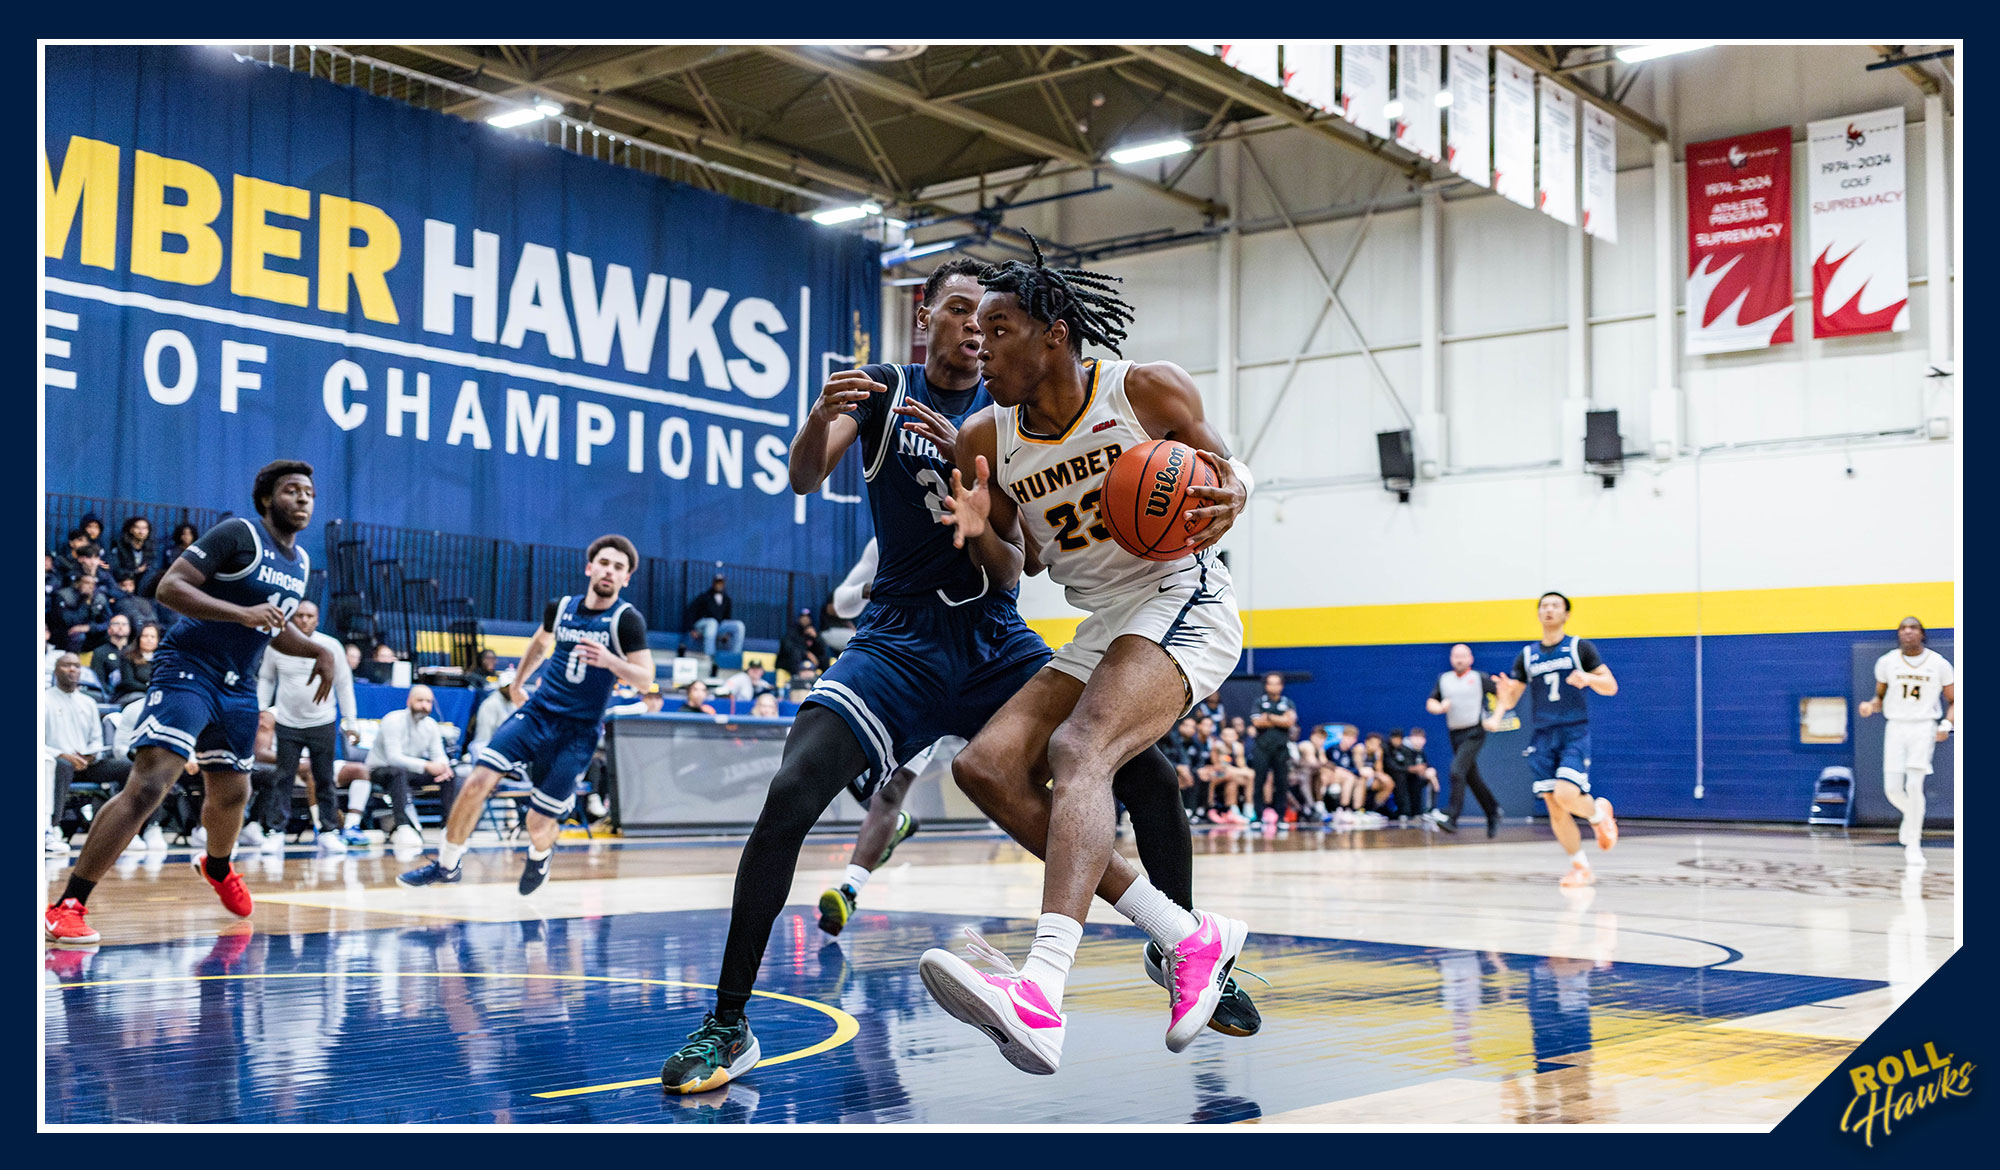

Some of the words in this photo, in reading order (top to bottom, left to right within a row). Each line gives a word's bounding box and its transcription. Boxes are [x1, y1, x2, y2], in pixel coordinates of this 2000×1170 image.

[1841, 175, 1873, 188] GOLF
[1708, 207, 1769, 226] PROGRAM
[1813, 189, 1905, 214] SUPREMACY
[1695, 223, 1783, 247] SUPREMACY
[422, 218, 791, 400] HAWKS
[143, 329, 268, 413] OF
[322, 358, 791, 495] CHAMPIONS
[1009, 443, 1122, 504] HUMBER
[1145, 447, 1185, 518] Wilson
[1044, 487, 1112, 552] 23
[1544, 672, 1560, 702] 7
[1903, 684, 1920, 700] 14
